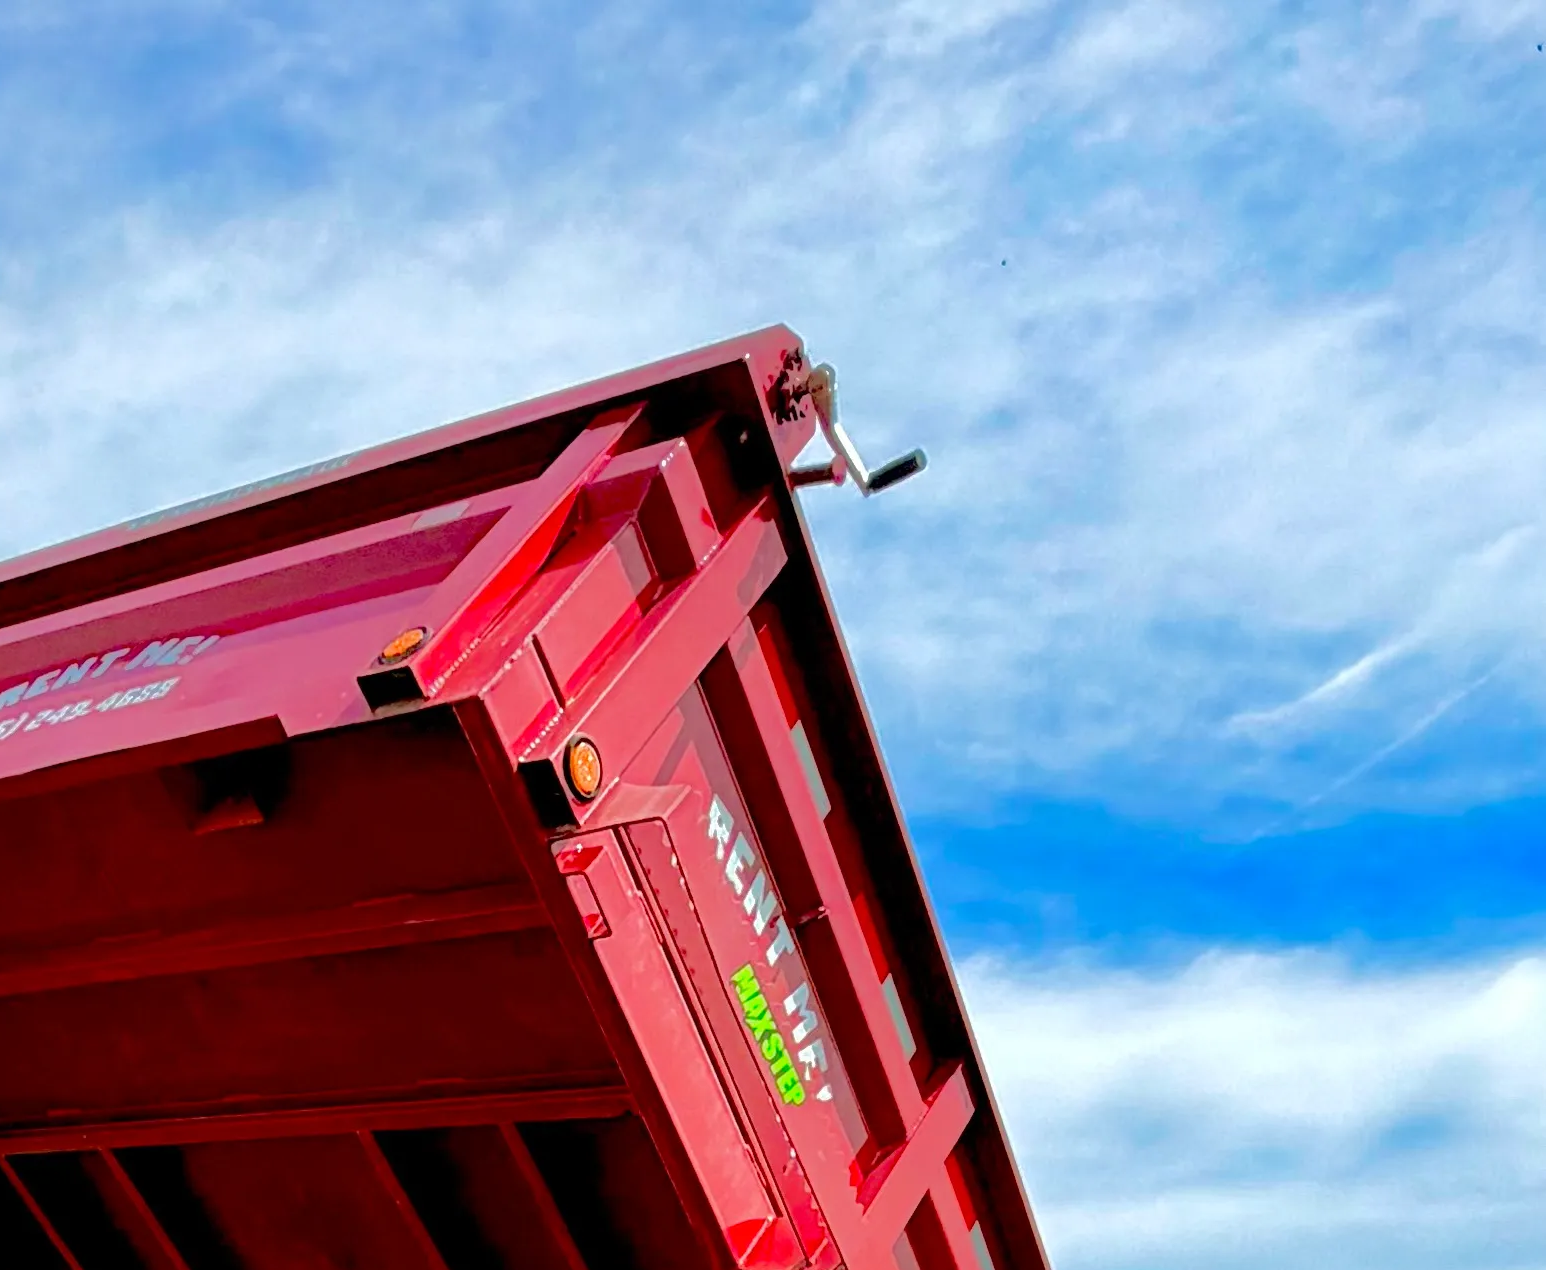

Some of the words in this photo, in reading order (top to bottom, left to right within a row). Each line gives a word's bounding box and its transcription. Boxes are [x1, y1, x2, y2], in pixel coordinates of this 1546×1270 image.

[125, 635, 220, 671] ME!
[708, 794, 796, 967] RENT
[730, 964, 805, 1105] MAXSTEP
